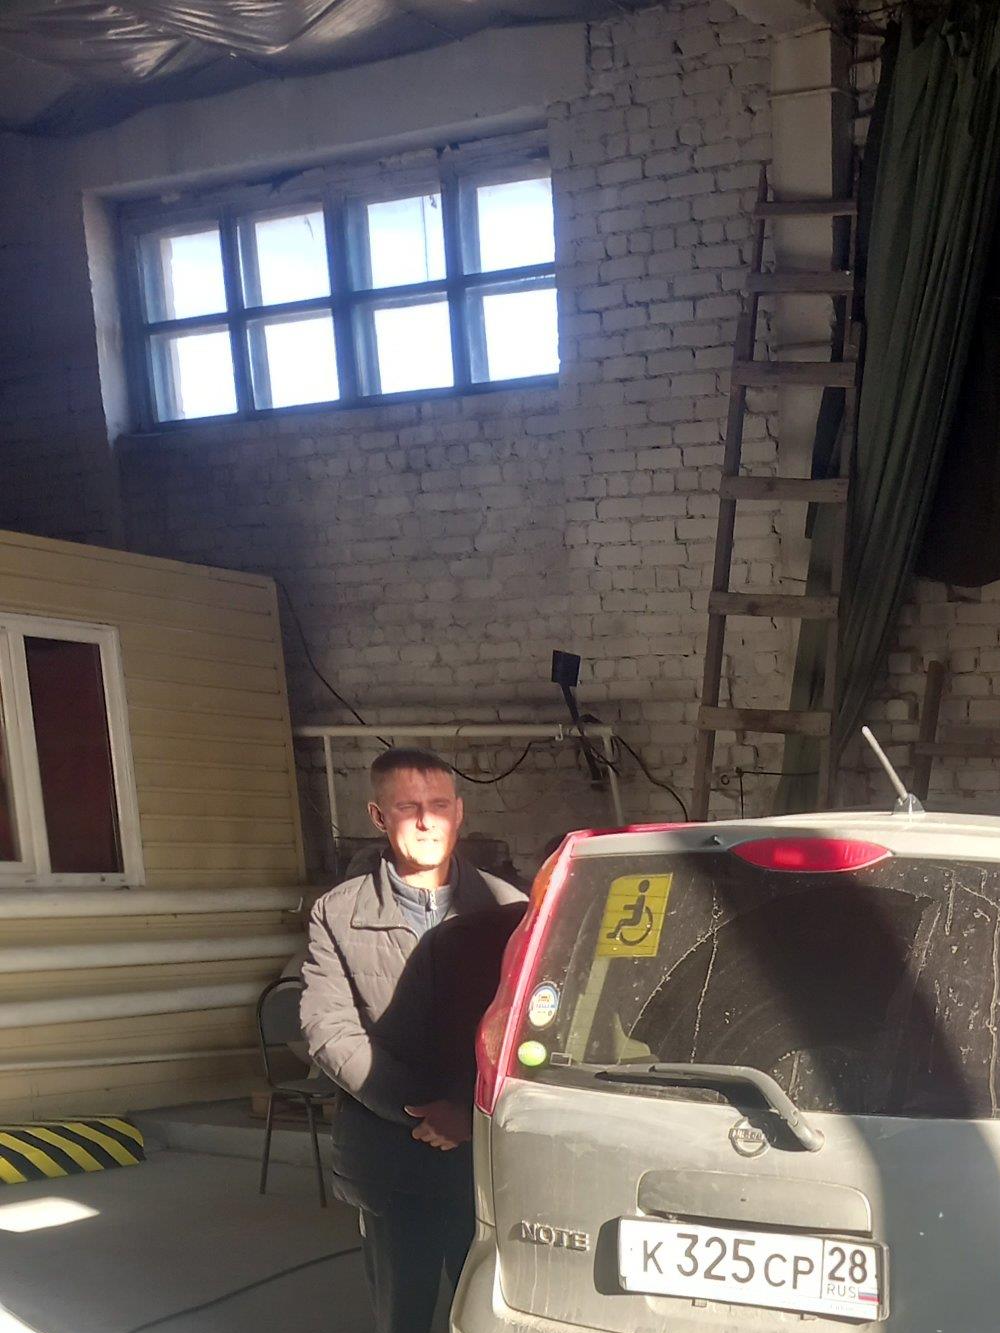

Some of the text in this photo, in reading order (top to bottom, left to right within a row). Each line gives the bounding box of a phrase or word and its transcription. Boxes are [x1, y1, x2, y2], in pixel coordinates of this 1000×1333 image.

[520, 1219, 590, 1251] NOTE
[827, 1246, 868, 1284] 28
[826, 1283, 856, 1299] RUS
